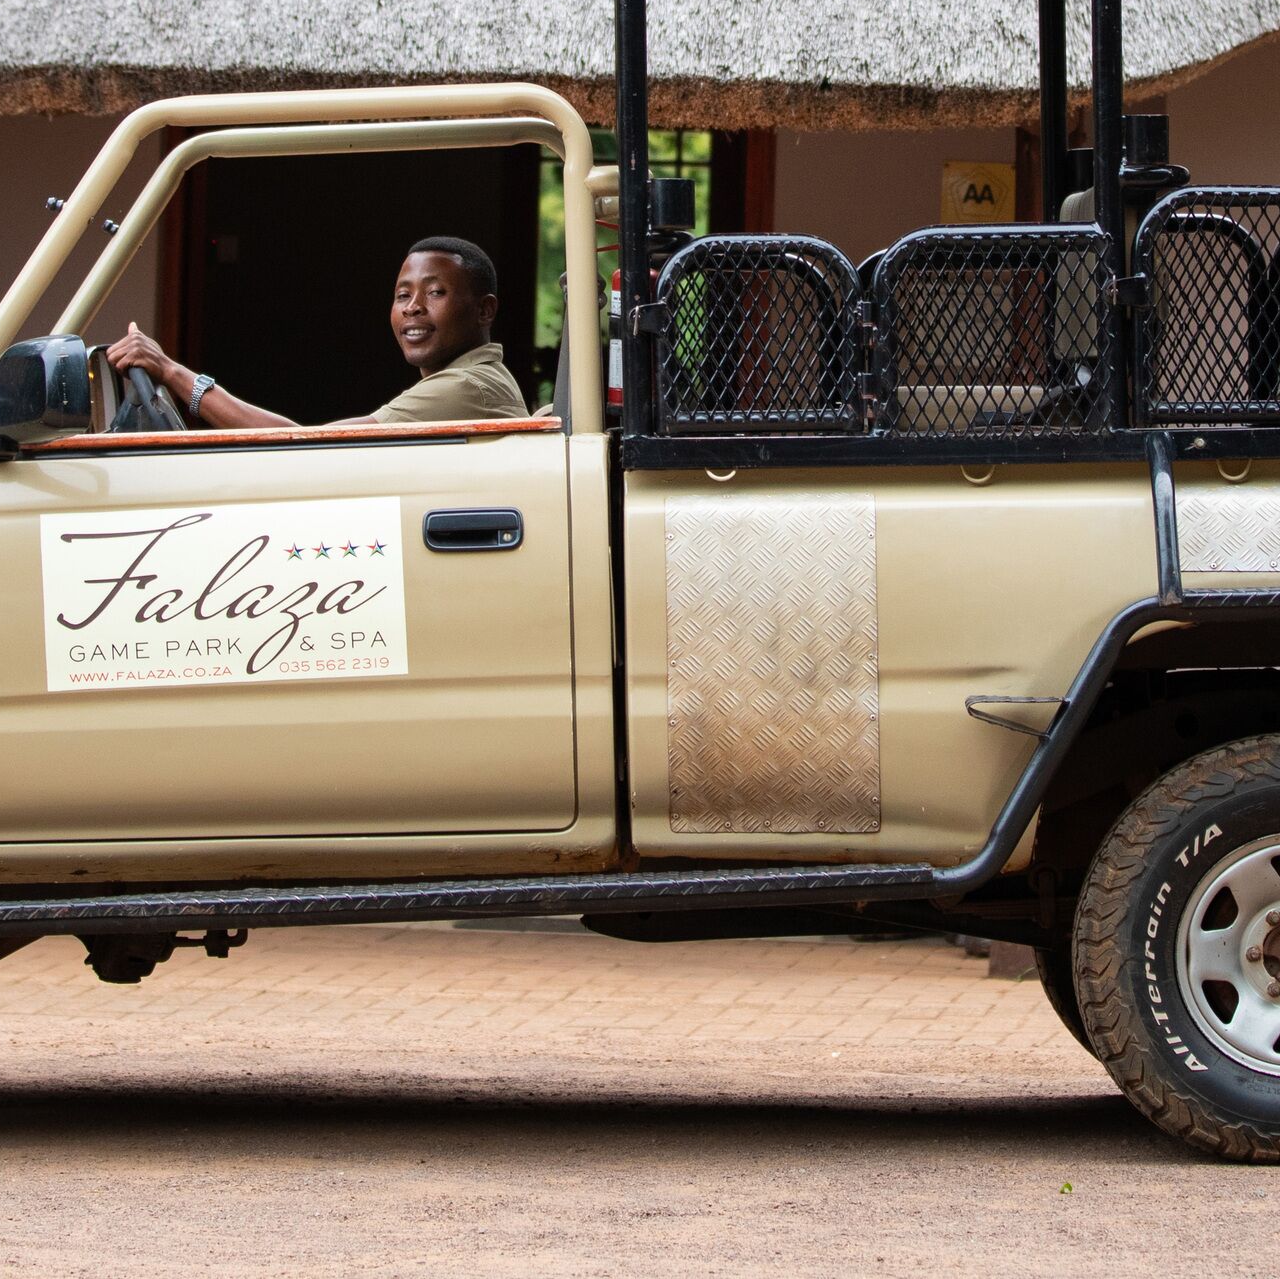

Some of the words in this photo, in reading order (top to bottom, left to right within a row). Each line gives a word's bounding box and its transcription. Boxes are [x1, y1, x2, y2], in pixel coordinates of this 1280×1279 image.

[963, 184, 995, 204] AA
[57, 513, 387, 674] Falaza
[69, 642, 150, 663] GAME
[166, 637, 243, 658] PARK
[300, 635, 316, 652] &
[331, 631, 387, 650] SPA
[69, 667, 232, 683] WWW.FALAZA.CO.ZA
[279, 660, 310, 673] 035
[316, 658, 346, 671] 562
[352, 657, 390, 670] 2319
[1174, 823, 1223, 869] T/A
[1144, 882, 1209, 1072] All-Terrain
